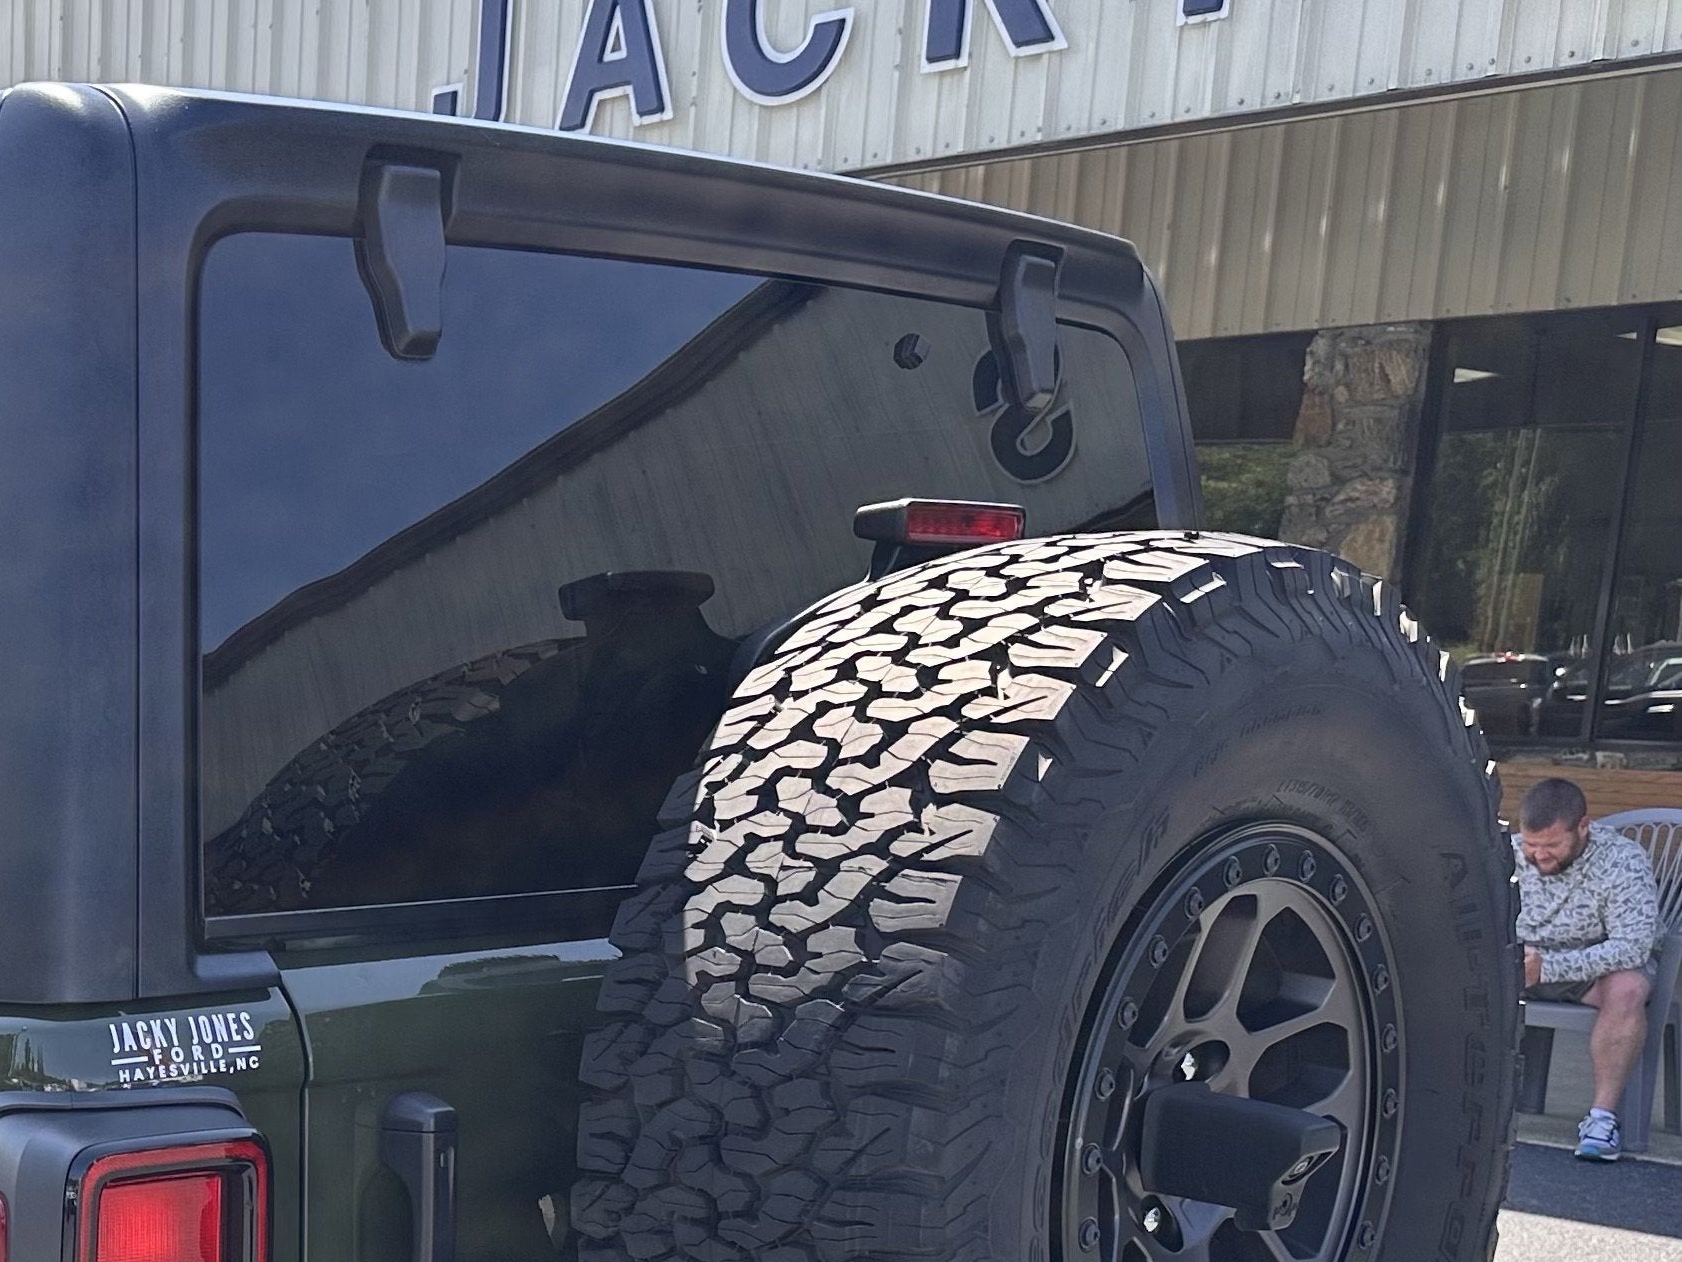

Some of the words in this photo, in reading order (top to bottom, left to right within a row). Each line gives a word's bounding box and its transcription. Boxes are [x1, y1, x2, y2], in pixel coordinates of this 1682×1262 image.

[109, 1017, 180, 1054] JACKY
[187, 1011, 255, 1045] JONES
[152, 1044, 224, 1065] FORD
